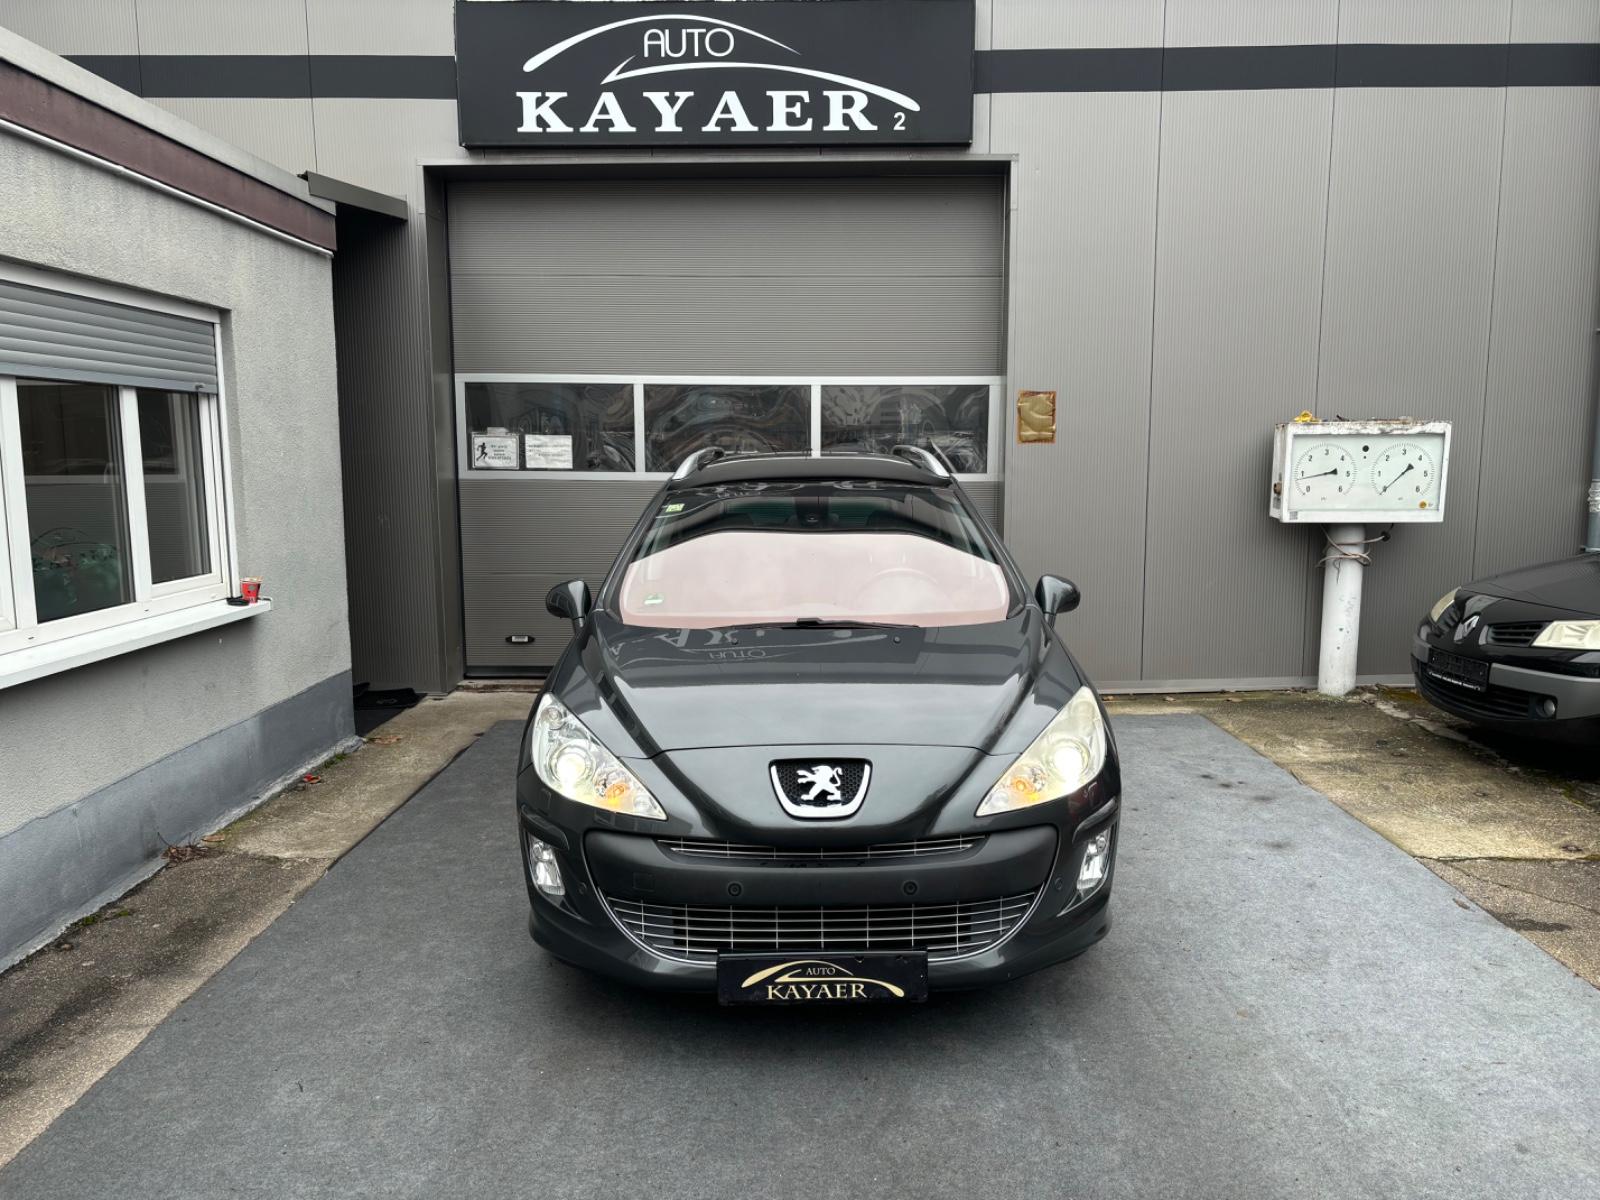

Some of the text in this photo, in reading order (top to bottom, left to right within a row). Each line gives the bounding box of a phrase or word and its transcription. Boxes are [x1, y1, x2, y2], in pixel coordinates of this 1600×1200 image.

[643, 27, 735, 58] AUTO
[515, 90, 907, 133] KAYAER 2
[805, 966, 836, 976] AUTO
[766, 984, 868, 1000] KAYAER
